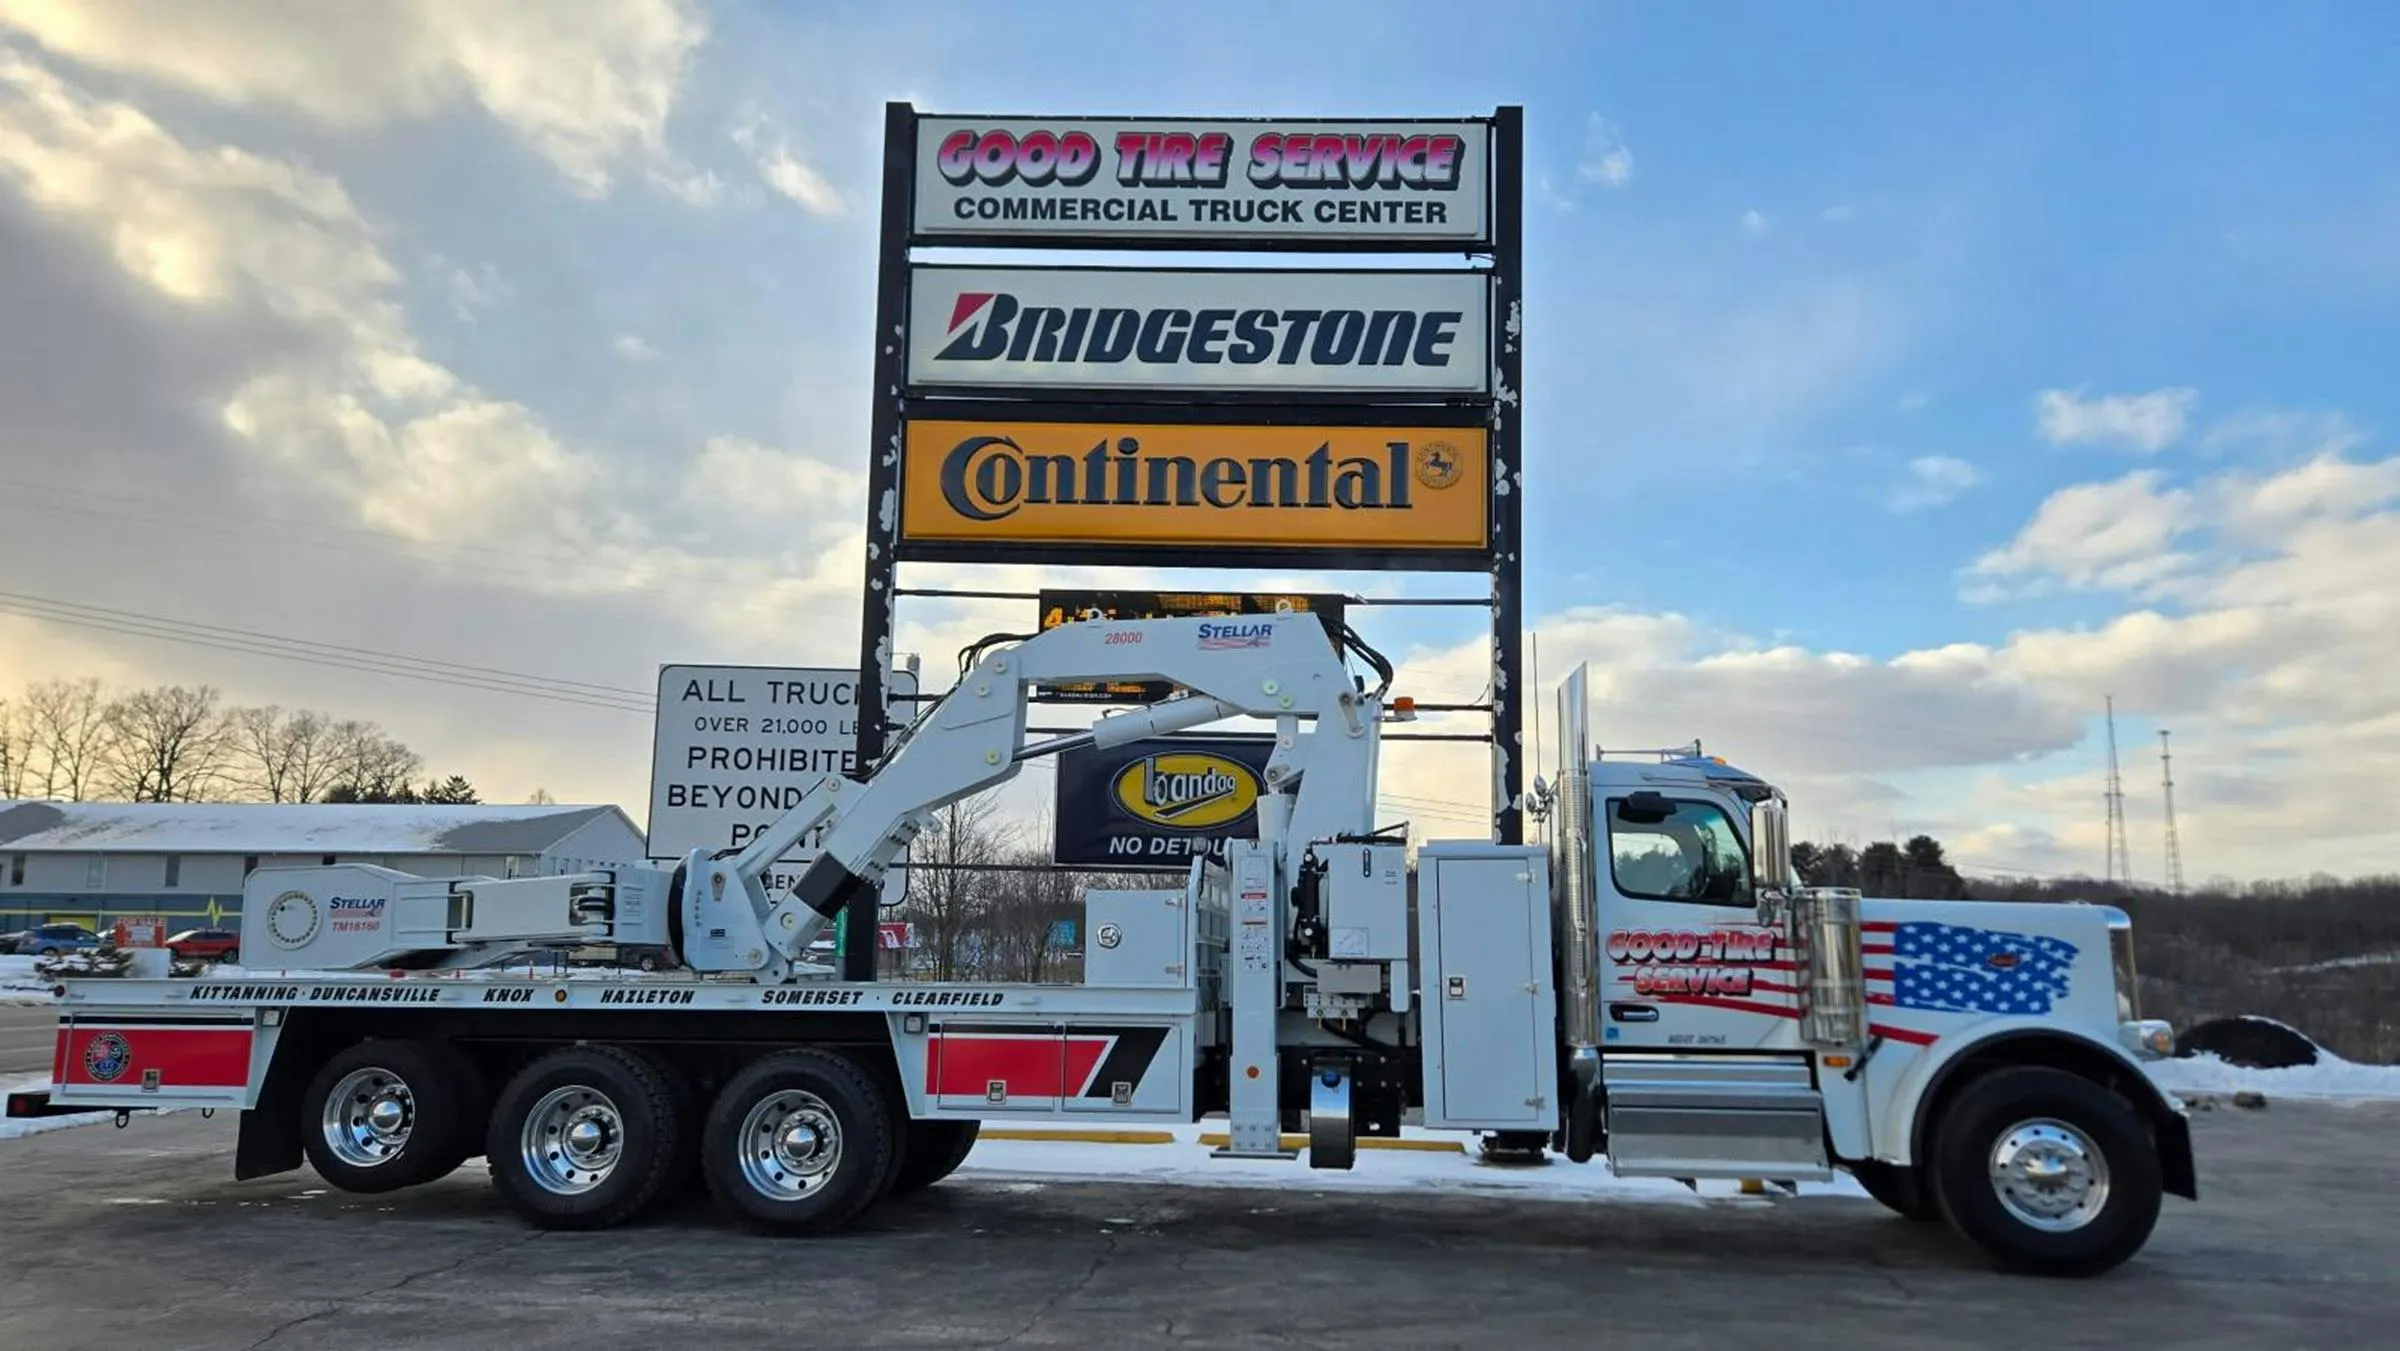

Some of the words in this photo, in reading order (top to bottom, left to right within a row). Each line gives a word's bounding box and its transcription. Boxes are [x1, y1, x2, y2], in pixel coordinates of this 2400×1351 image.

[938, 130, 1101, 187] GOOD
[1115, 132, 1234, 188] TIRE
[1247, 132, 1466, 191] SERVICE
[954, 197, 1178, 222] COMMERCIAL
[1189, 199, 1303, 222] TRUCK
[1314, 201, 1447, 223] CENTER
[933, 293, 1463, 367] BRIDGESTONE
[940, 436, 1412, 521] Continental
[1104, 631, 1143, 645] 28000
[1198, 623, 1273, 639] STELLAR
[682, 679, 746, 703] ALL
[767, 681, 861, 706] TRUC
[694, 717, 748, 733] OVER
[687, 746, 858, 773] PROHIBITE
[667, 784, 803, 810] BEYOND
[1109, 836, 1143, 855] NO
[329, 896, 386, 910] STELLAR
[1606, 930, 1699, 963] GOOD
[1710, 931, 1776, 962] TIRE
[1633, 966, 1754, 996] SERVICE
[189, 985, 298, 1001] KITTANNING
[309, 987, 441, 1002] DUNCANSVILLE
[483, 988, 535, 1003] KNOX
[600, 989, 694, 1004] HAZLETON
[761, 990, 864, 1006] SOMERSET
[891, 992, 1004, 1007] CLEARFIELD
